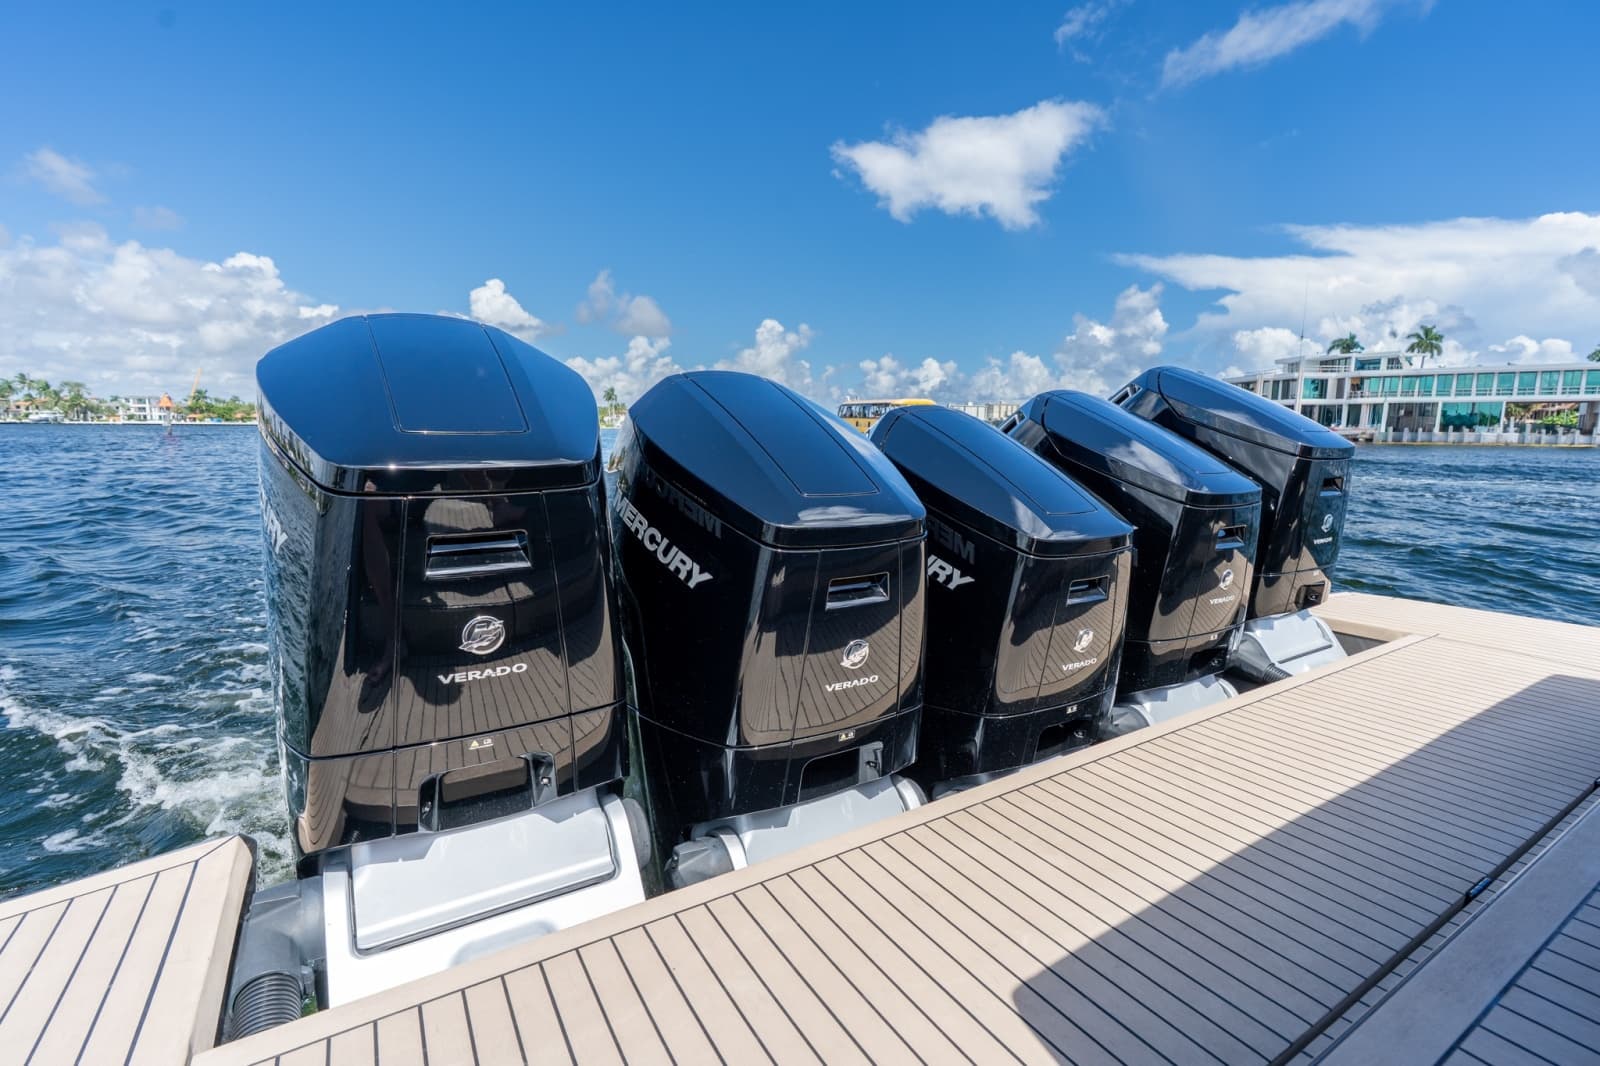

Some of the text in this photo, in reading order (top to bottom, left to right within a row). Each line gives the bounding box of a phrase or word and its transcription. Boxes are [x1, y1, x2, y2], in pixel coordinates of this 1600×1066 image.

[613, 489, 714, 589] MERCURY
[437, 663, 528, 685] VERADO
[1062, 657, 1098, 671] VERADO
[825, 674, 879, 692] VERADO
